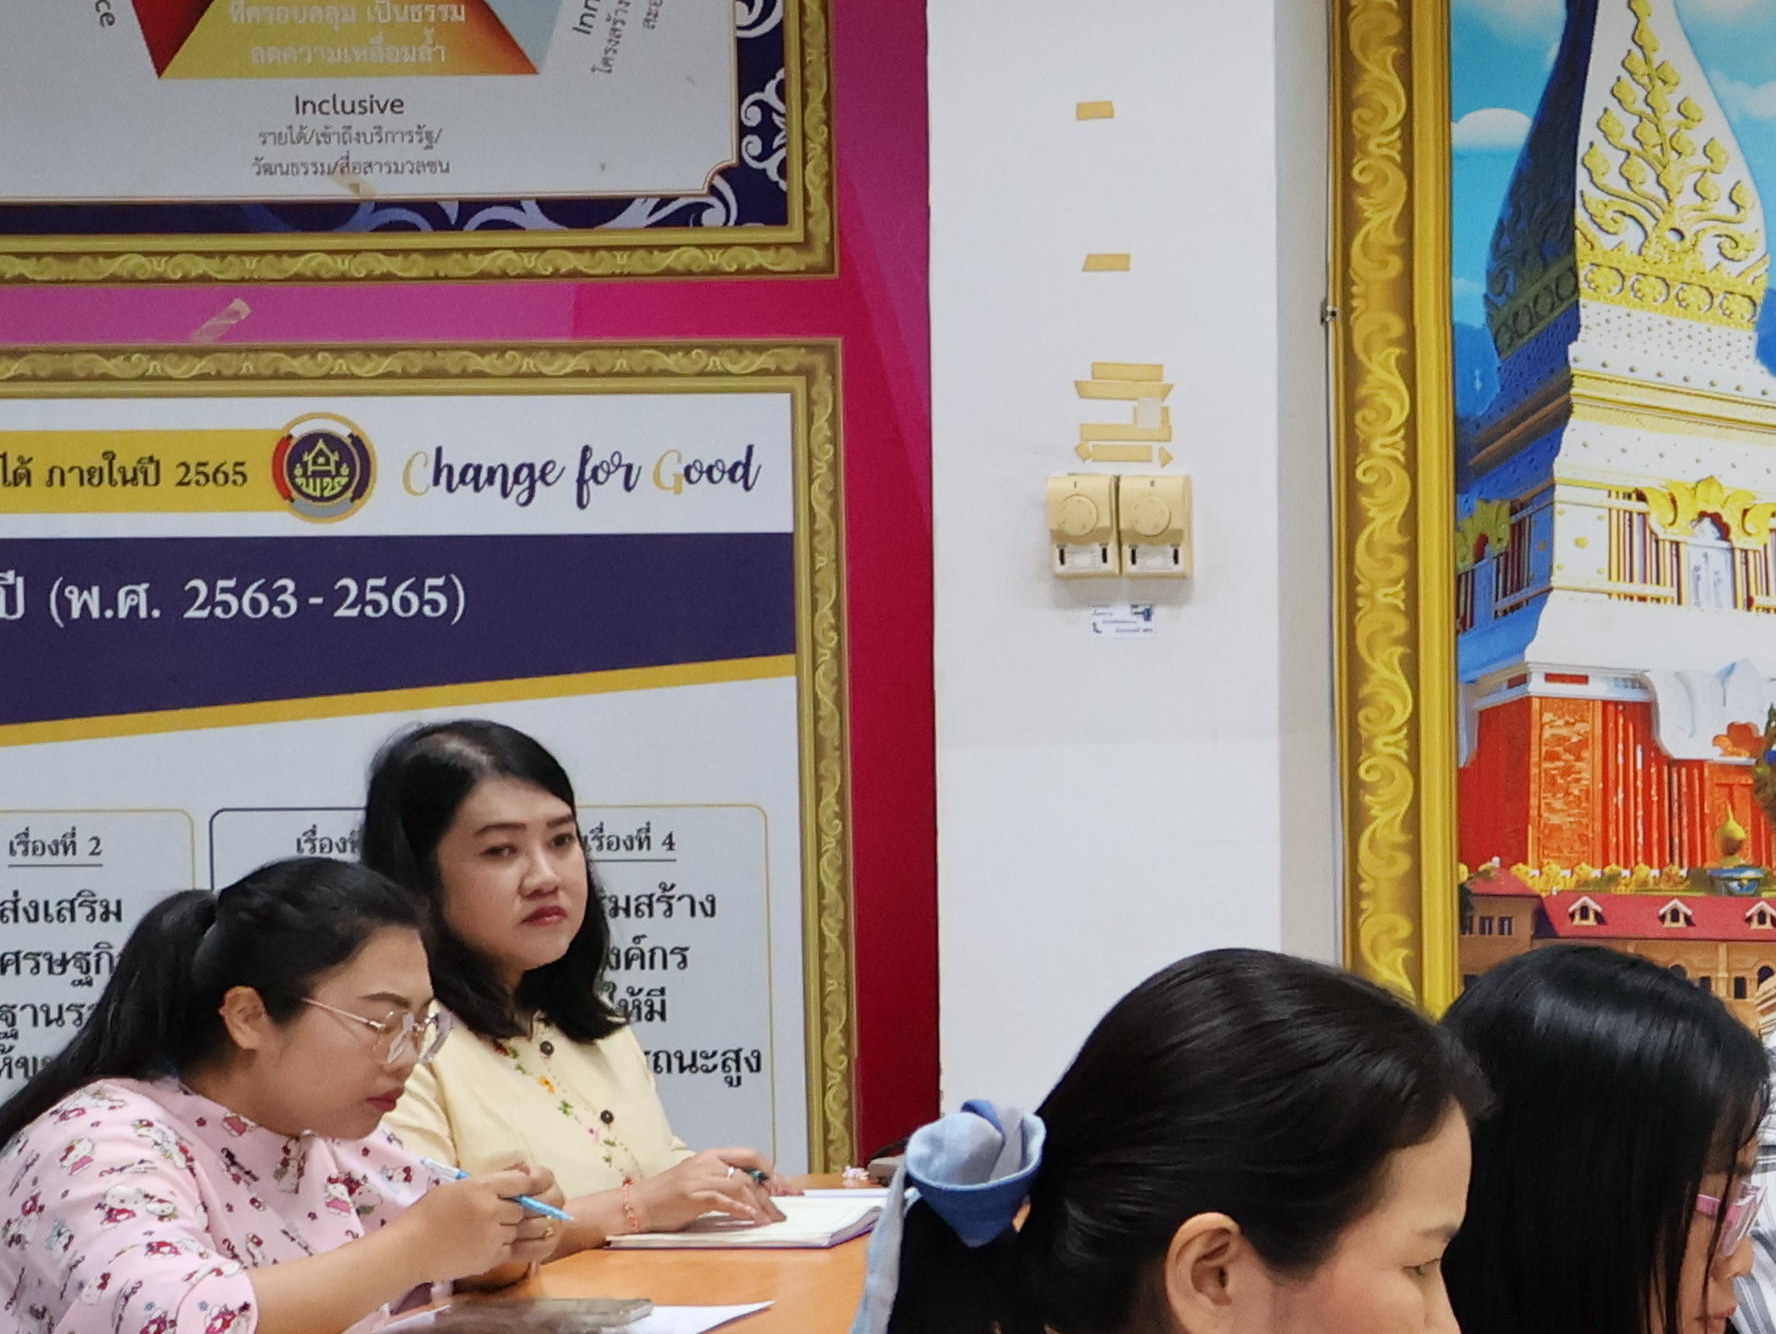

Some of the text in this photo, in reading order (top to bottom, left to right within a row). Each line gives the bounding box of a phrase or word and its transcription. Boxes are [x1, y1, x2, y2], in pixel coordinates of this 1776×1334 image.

[294, 94, 405, 116] Inclusive
[45, 451, 162, 488] ภายในปี
[175, 461, 249, 488] 2565
[403, 444, 762, 510] Change for Good
[50, 577, 161, 628] (พ.ศ.
[8, 826, 104, 857] เรื่องที่ 2
[661, 831, 676, 852] 4
